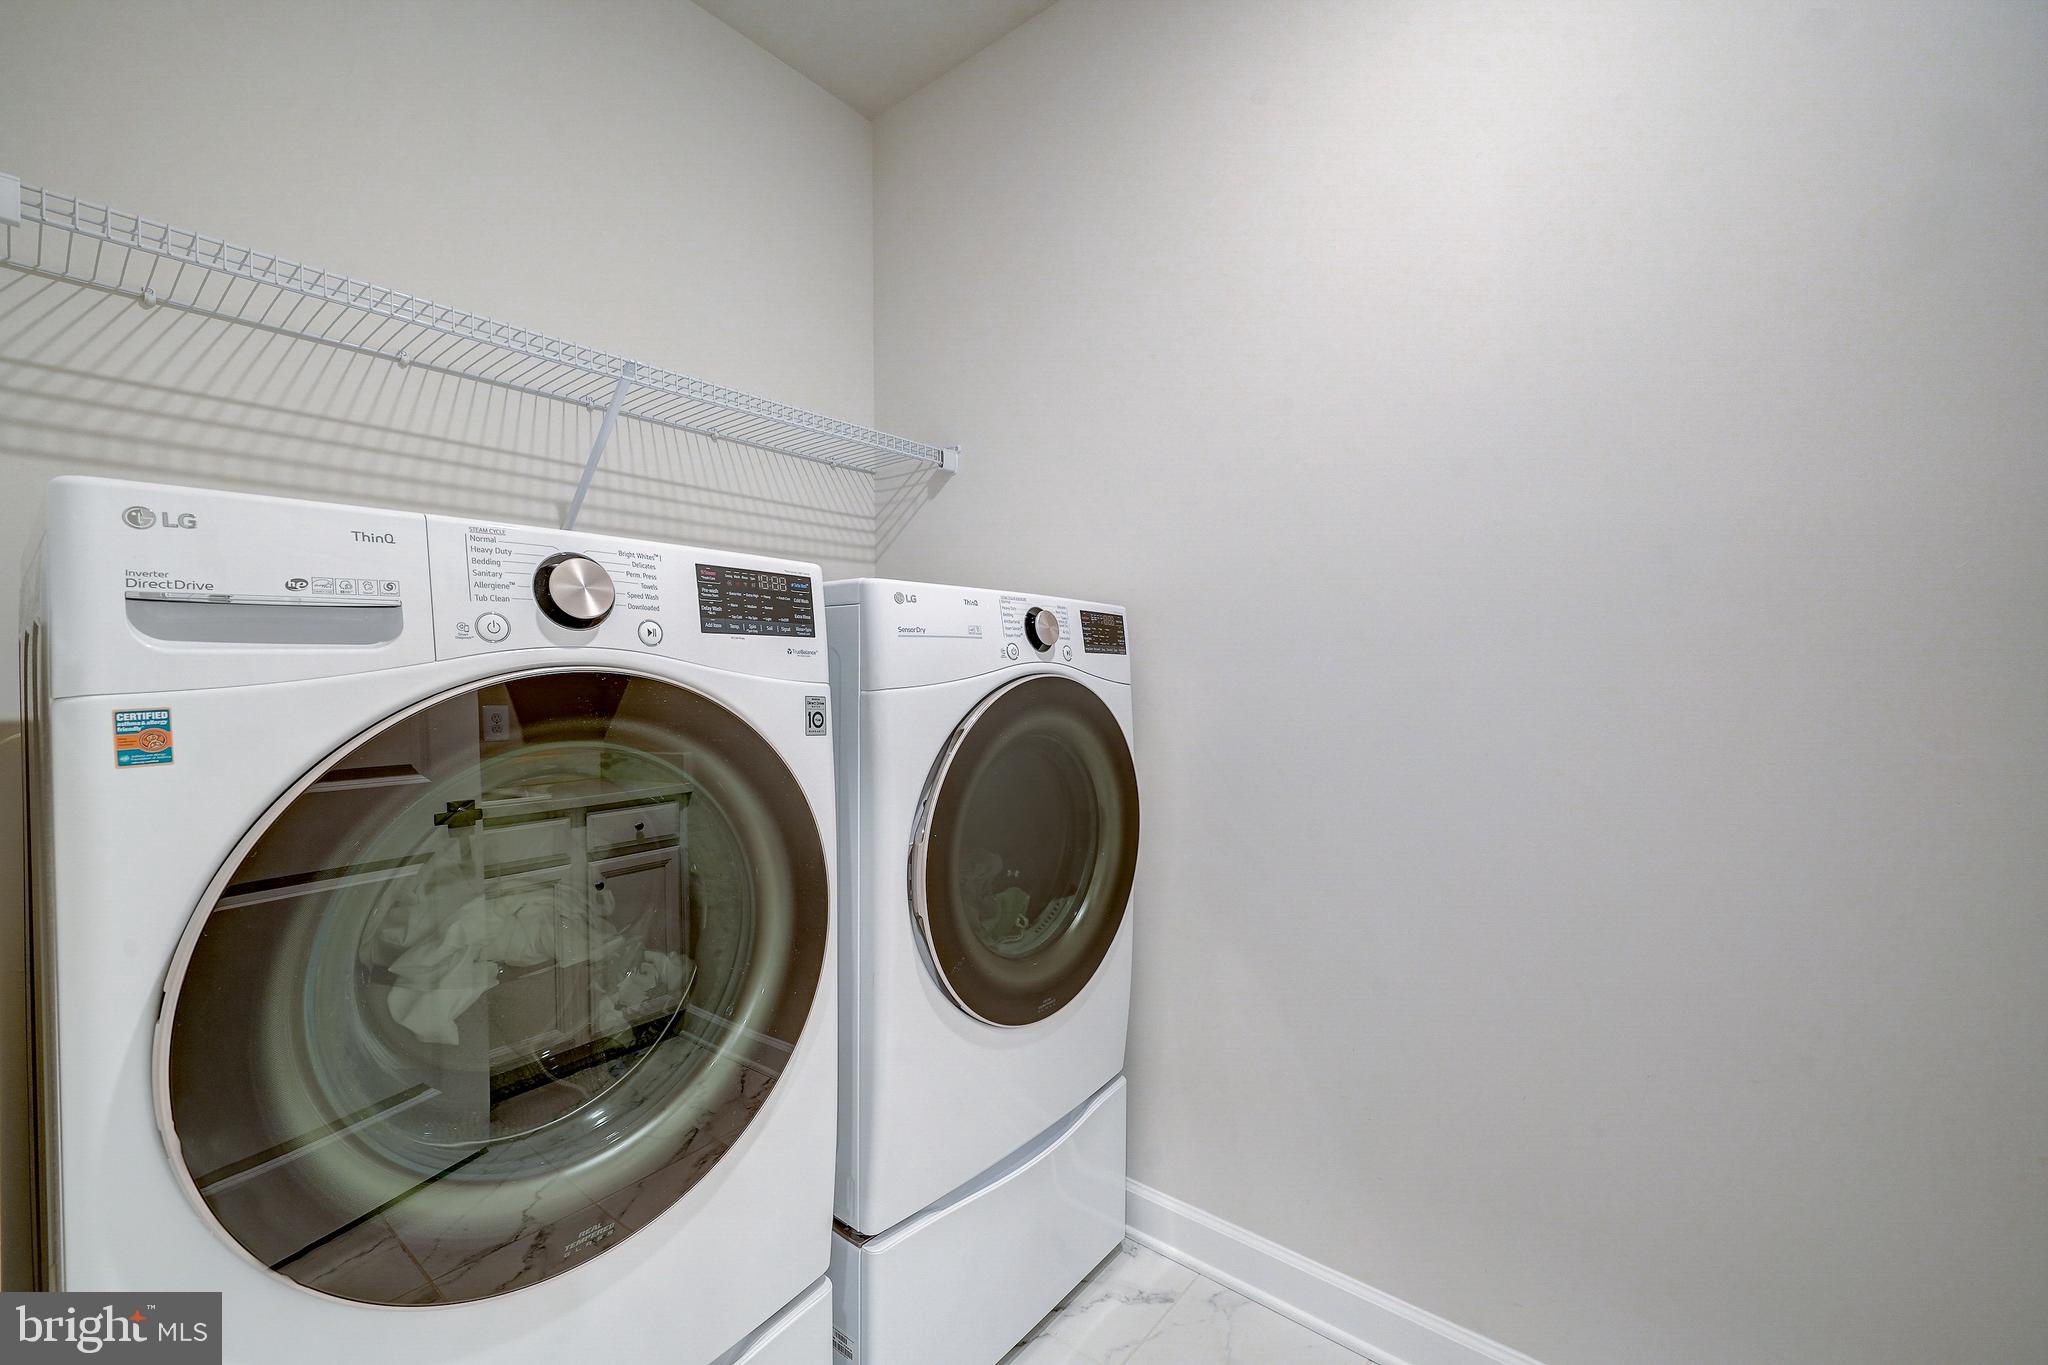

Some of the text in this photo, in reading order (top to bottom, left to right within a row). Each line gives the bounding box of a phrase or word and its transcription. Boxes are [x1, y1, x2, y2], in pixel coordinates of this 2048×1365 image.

[162, 511, 197, 529] LG
[351, 531, 396, 545] ThinQ
[470, 535, 497, 544] Normal
[471, 546, 512, 556] Heavy Duty
[618, 550, 636, 560] Bright
[472, 558, 501, 567] Bedding
[632, 562, 656, 570] Delicates
[125, 569, 169, 579] Inverter
[472, 569, 503, 579] Sanitary
[643, 573, 657, 581] Press
[641, 583, 658, 591] Towels
[475, 594, 511, 603] Tub Clean
[627, 592, 644, 600] Speed
[905, 595, 917, 603] LG
[627, 603, 660, 612] Downloaded
[116, 711, 168, 722] CERTIFIED
[807, 711, 824, 729] 10
[578, 1223, 602, 1238] REAL
[565, 1222, 615, 1252] TEMPERED
